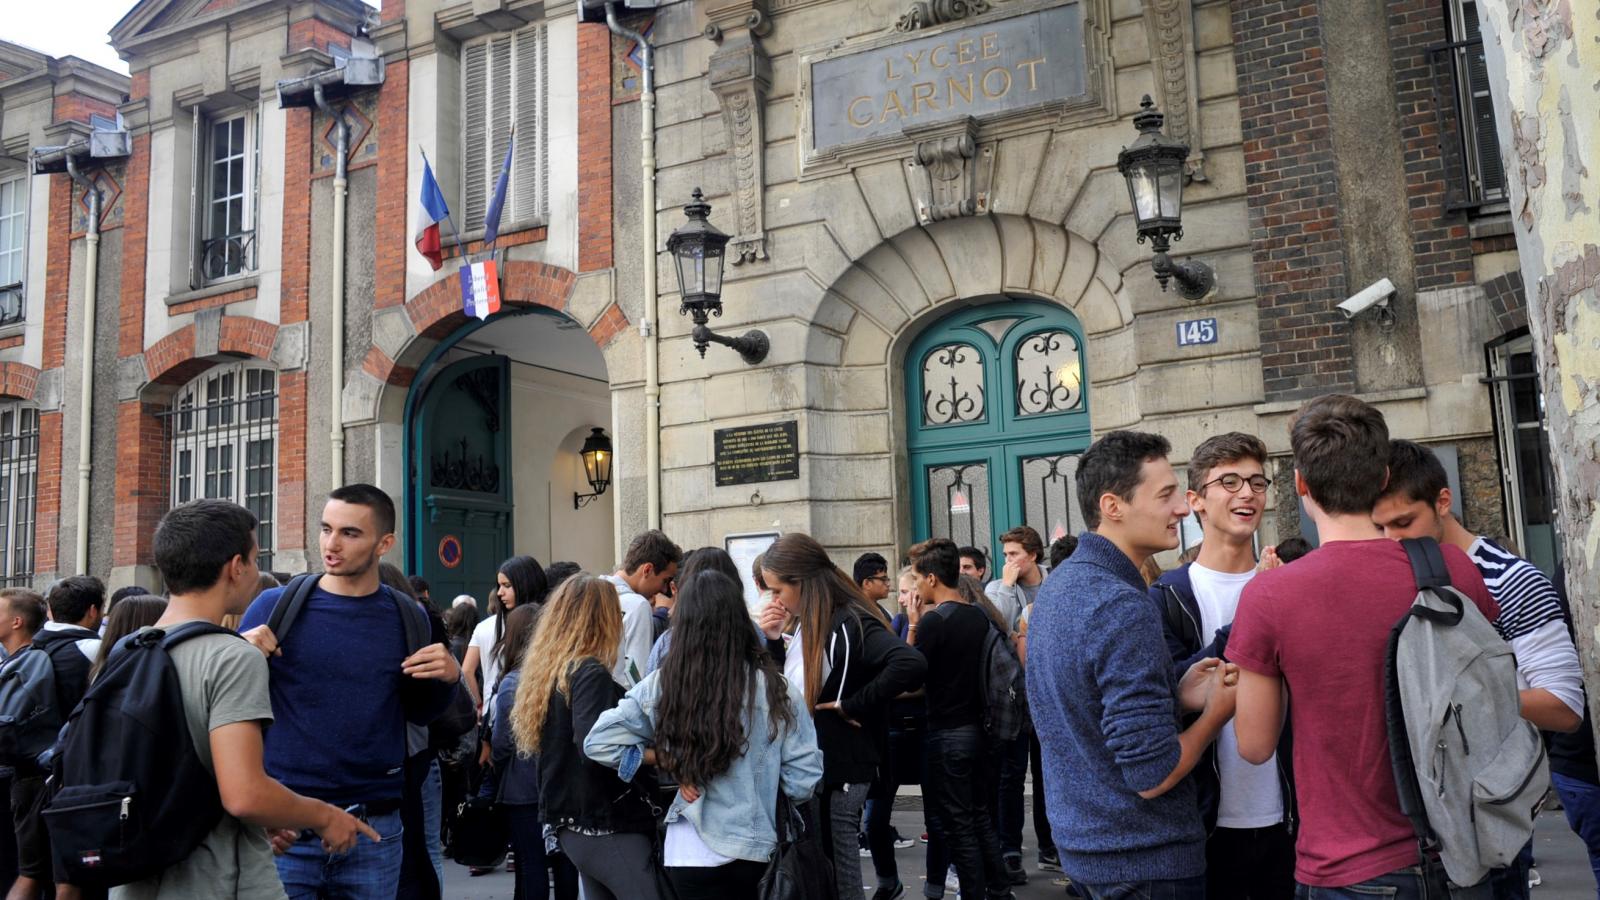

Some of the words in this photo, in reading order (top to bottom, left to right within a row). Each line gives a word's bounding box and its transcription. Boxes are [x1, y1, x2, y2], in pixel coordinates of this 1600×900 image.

[885, 32, 1001, 80] LYCÉE
[847, 57, 1047, 129] CARNOT
[1178, 319, 1214, 345] 145
